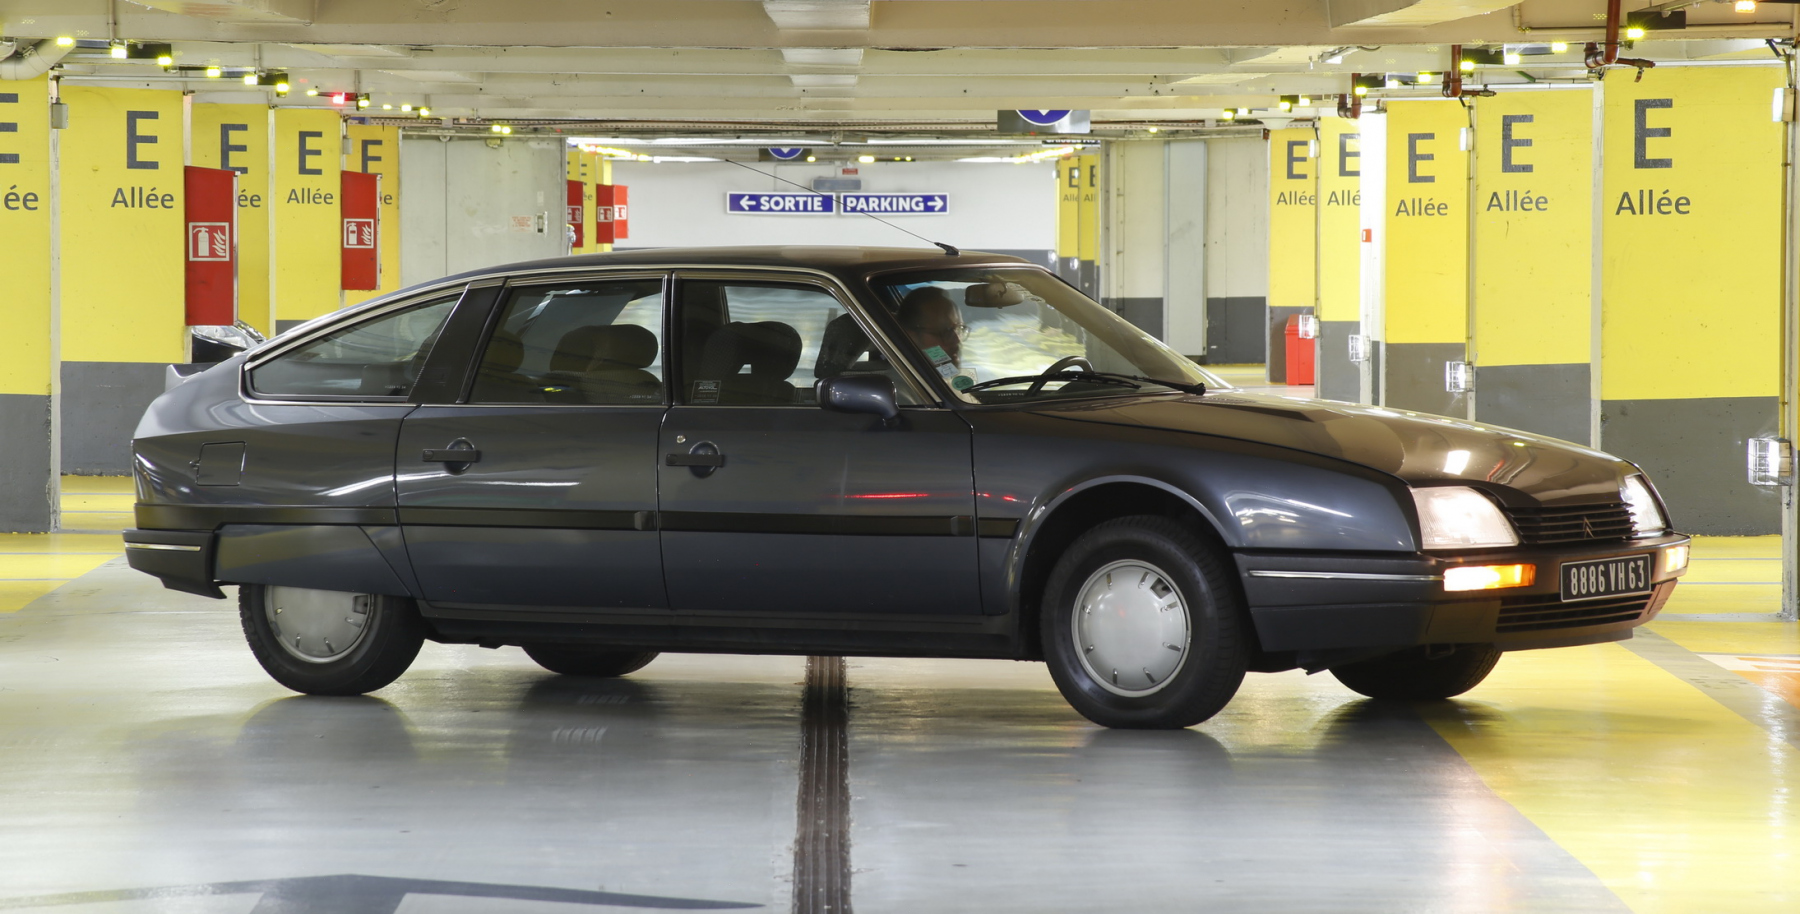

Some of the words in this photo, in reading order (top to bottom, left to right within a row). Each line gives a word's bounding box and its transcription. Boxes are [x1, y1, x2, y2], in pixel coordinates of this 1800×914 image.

[126, 110, 159, 170] E
[220, 123, 249, 175] E
[1502, 114, 1534, 173] E
[1634, 98, 1673, 169] E
[298, 130, 323, 175] E
[1286, 140, 1308, 180] E
[1338, 133, 1361, 177] E
[1408, 132, 1436, 184] E
[110, 186, 175, 210] Allée
[286, 187, 334, 205] Allée
[759, 196, 823, 212] SORTIE
[846, 196, 925, 212] PARKING
[1327, 189, 1361, 206] Allé
[1395, 197, 1449, 217] Allée
[1486, 189, 1549, 212] Allée
[1615, 188, 1692, 216] Allée
[1570, 564, 1606, 596] 8886
[1609, 562, 1626, 592] VH
[1628, 560, 1645, 590] 63
